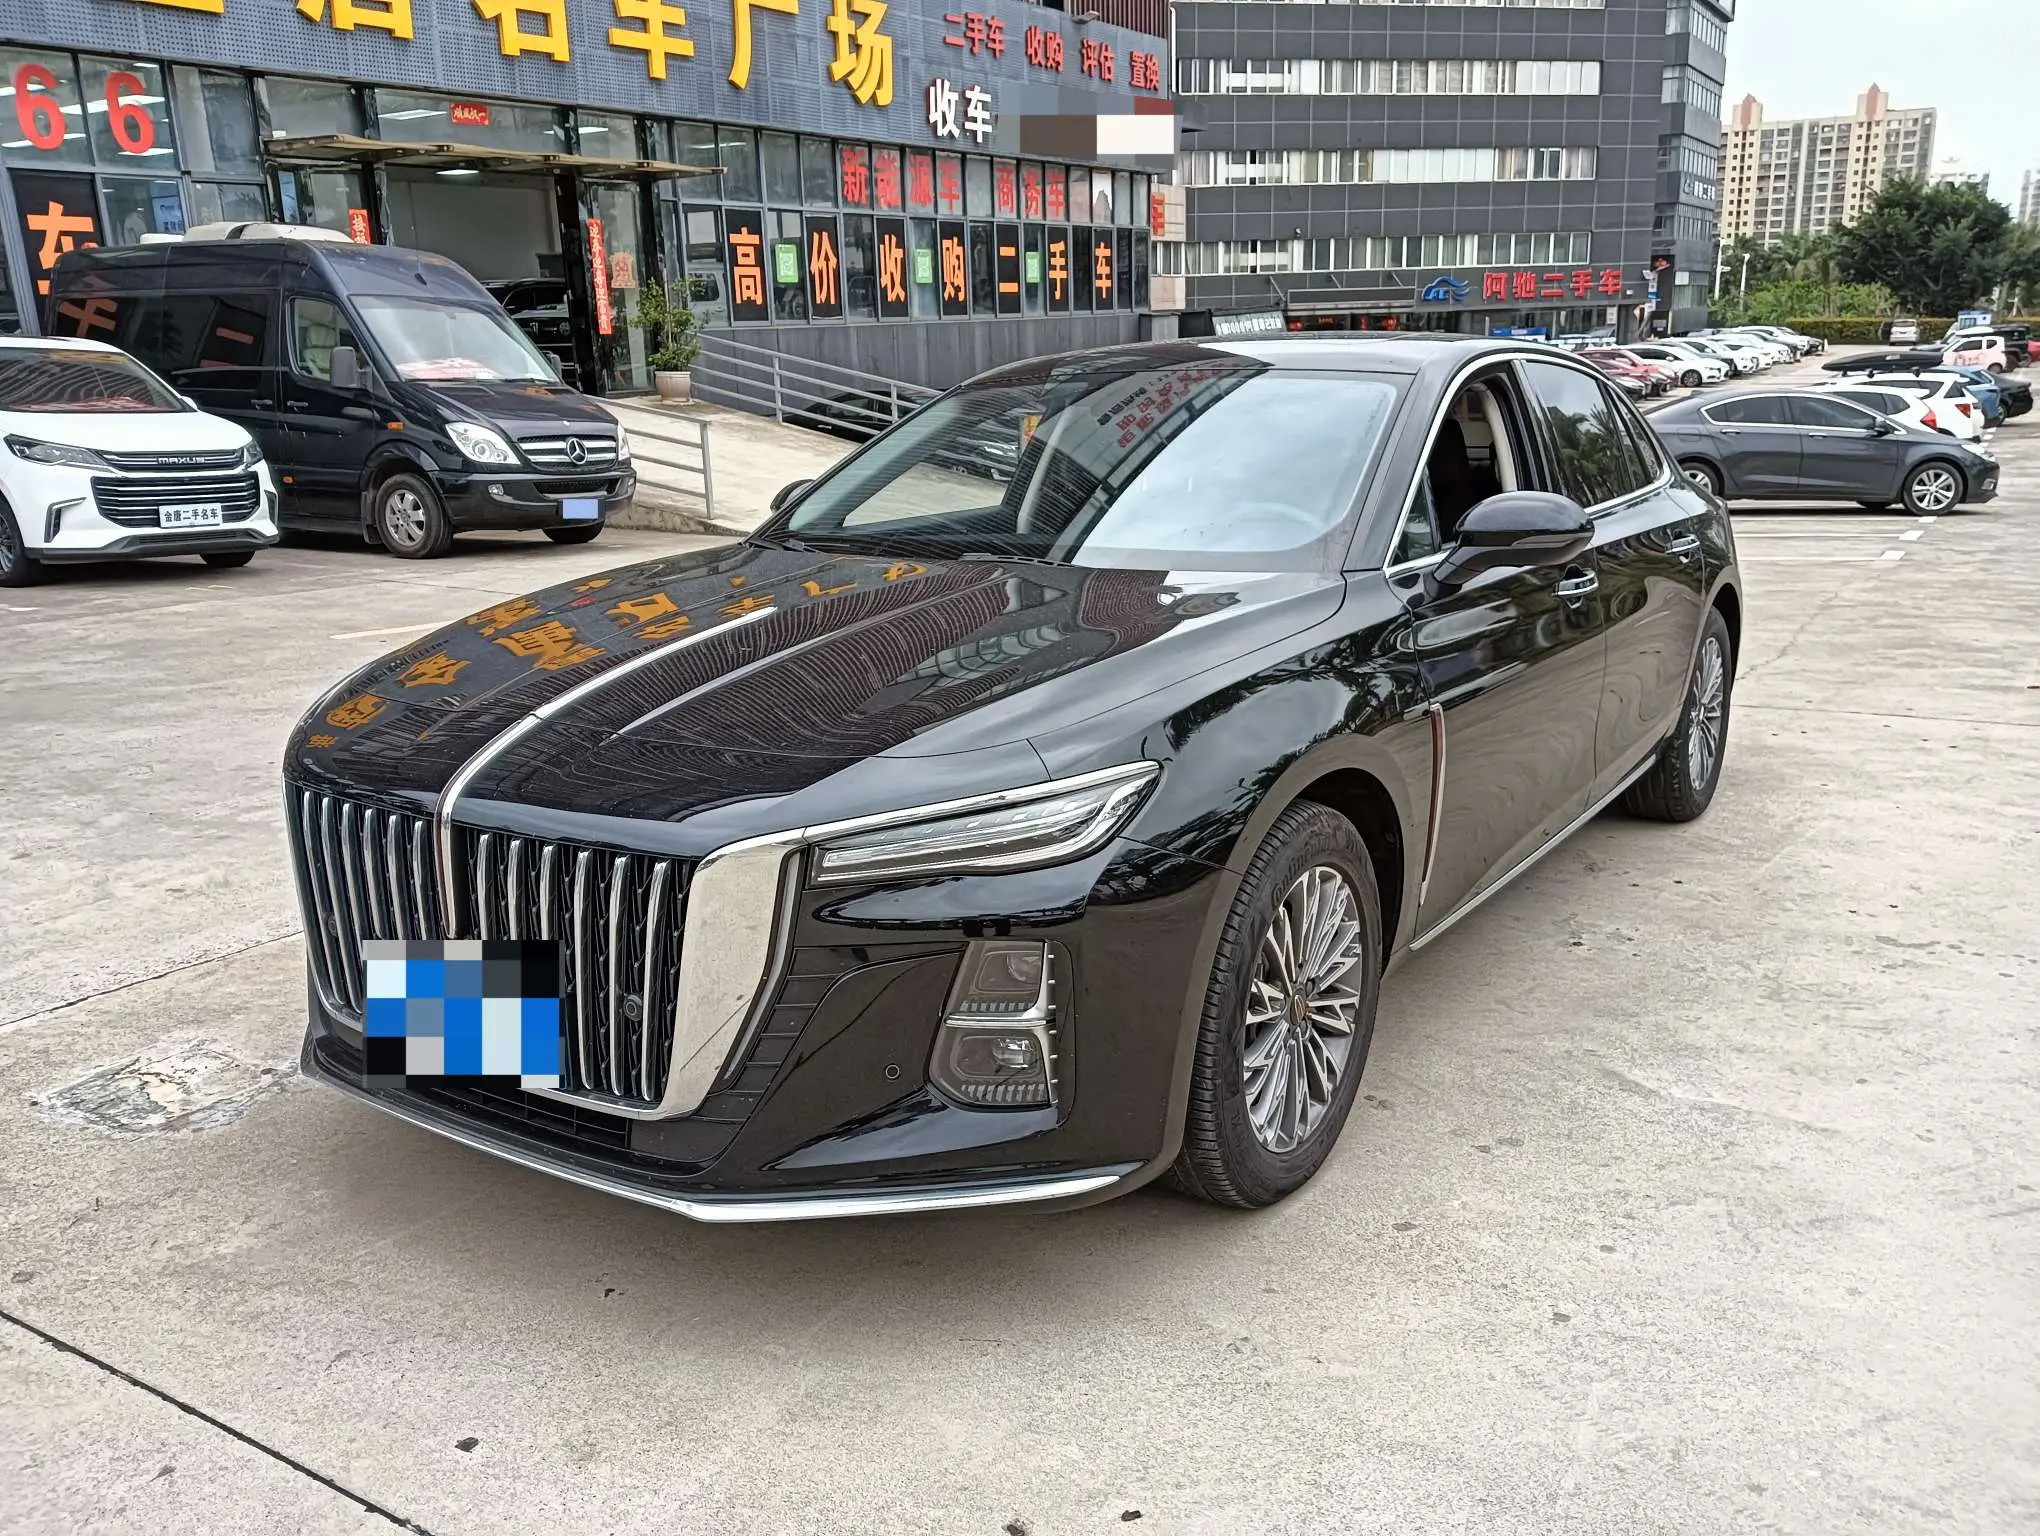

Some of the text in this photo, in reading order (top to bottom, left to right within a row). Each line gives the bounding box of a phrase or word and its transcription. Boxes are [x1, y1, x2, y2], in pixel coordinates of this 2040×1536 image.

[943, 11, 1160, 91] 二手车 收购 评估 置换
[927, 77, 993, 143] 收车
[841, 146, 1066, 217] 新能源车 商务车
[729, 226, 1112, 304] 高价收购二手车
[1483, 268, 1623, 302] 阿驰二手车
[164, 507, 219, 523] 金唐二手名车
